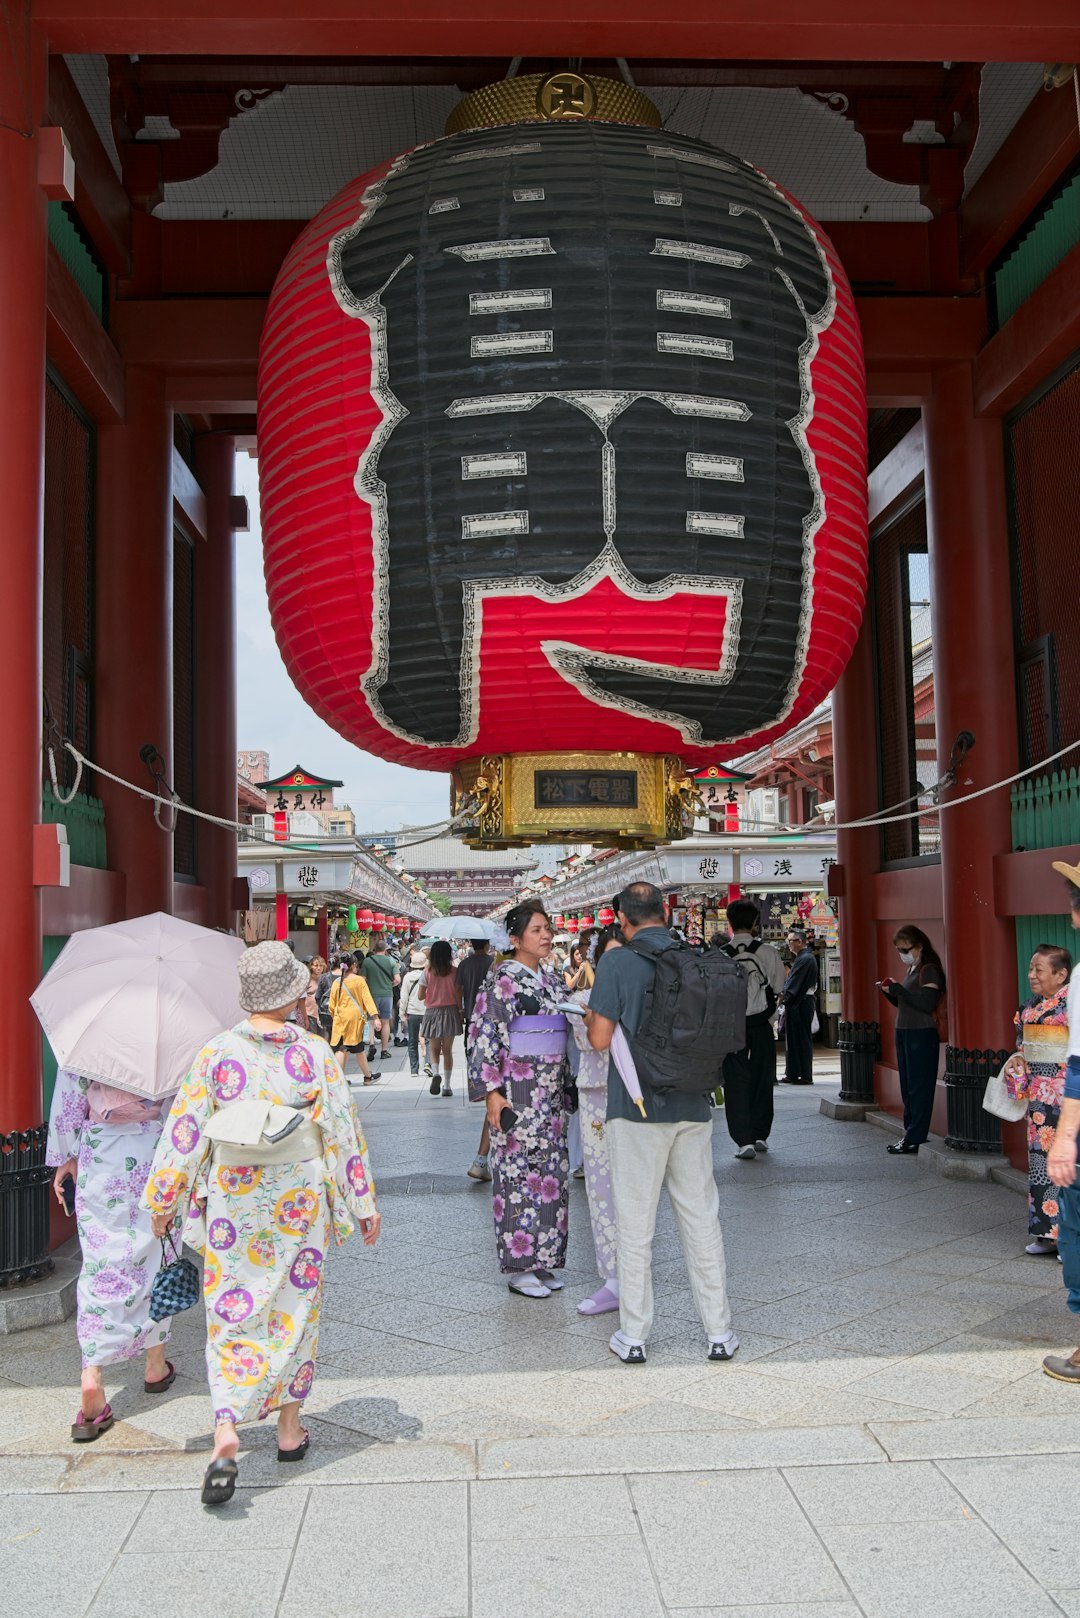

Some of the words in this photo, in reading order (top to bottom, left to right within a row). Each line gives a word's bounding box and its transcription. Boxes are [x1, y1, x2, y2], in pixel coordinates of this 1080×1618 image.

[328, 120, 835, 748] 雷門
[543, 776, 631, 801] 松下電器
[707, 782, 739, 803] 見世
